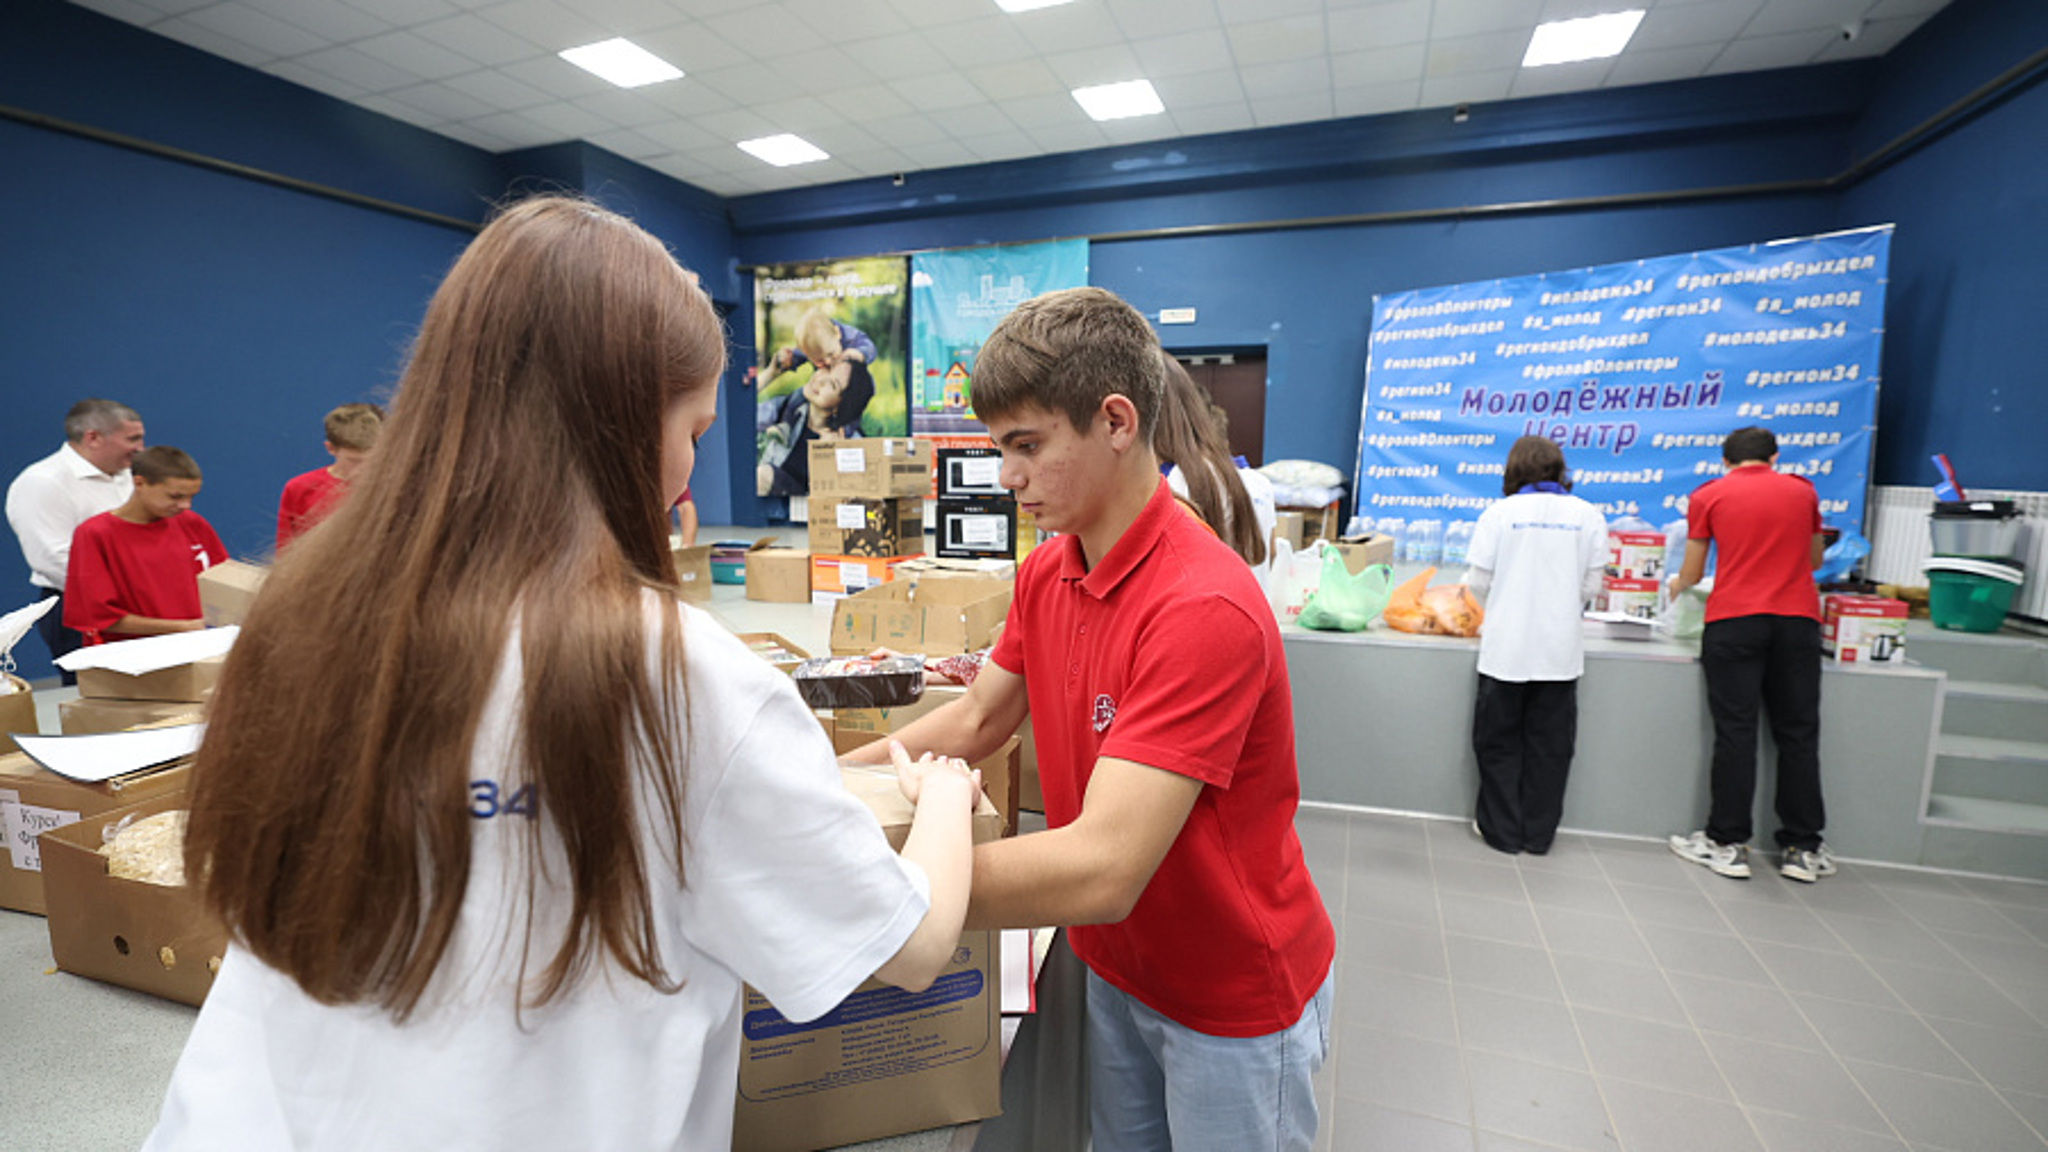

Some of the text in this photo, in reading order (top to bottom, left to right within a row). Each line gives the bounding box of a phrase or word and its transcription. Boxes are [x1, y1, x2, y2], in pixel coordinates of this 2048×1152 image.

[1677, 255, 1875, 292] #региондобрыхдел
[1541, 278, 1655, 306] #молодежь34
[1756, 291, 1862, 314] #я_молод
[1523, 311, 1602, 330] #я_молод
[1621, 297, 1723, 323] #регион34
[1375, 320, 1505, 343] #региондобрыхдел
[1704, 321, 1847, 348] #молодежь34
[1496, 331, 1649, 357] #региондобрыхдел
[1745, 364, 1860, 388] #регион34
[1380, 382, 1452, 399] #регион34
[1460, 370, 1723, 417] Молодёжный
[1737, 401, 1840, 419] #я_молод
[1367, 464, 1439, 479] #регион34
[1572, 468, 1664, 486] #регион34
[1371, 492, 1498, 510] #региондобрыхде
